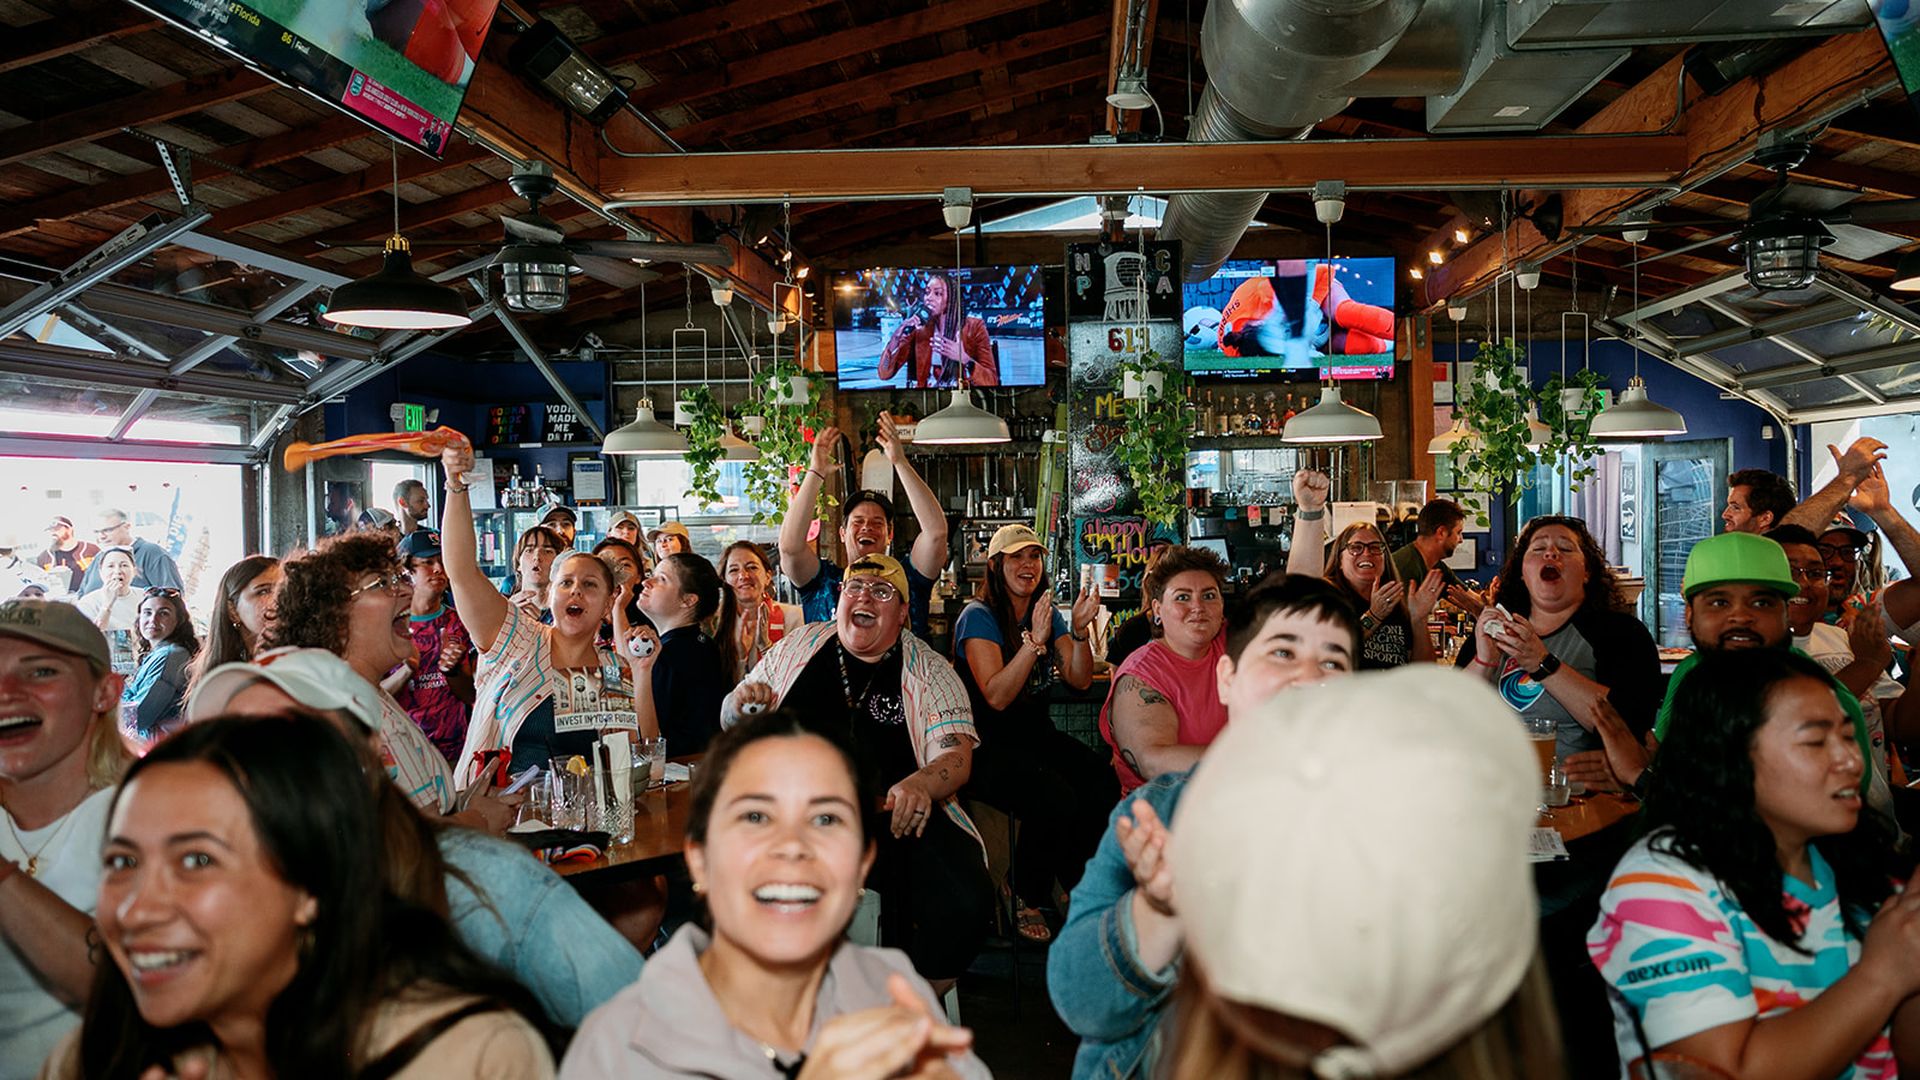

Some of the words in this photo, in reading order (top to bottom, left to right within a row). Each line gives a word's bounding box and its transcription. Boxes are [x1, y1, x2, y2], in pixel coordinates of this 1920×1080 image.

[234, 5, 262, 27] Florida
[281, 31, 293, 45] 86
[1108, 327, 1150, 353] 619
[546, 404, 576, 414] VOD
[406, 404, 424, 432] EXIT
[548, 413, 579, 424] MADE
[553, 424, 570, 433] ME
[562, 432, 575, 442] IT
[1085, 518, 1149, 550] HAPPY
[1111, 541, 1157, 568] HOU
[1364, 649, 1405, 664] SPORTS
[556, 714, 583, 727] INVEST
[614, 713, 636, 725] FUTURE
